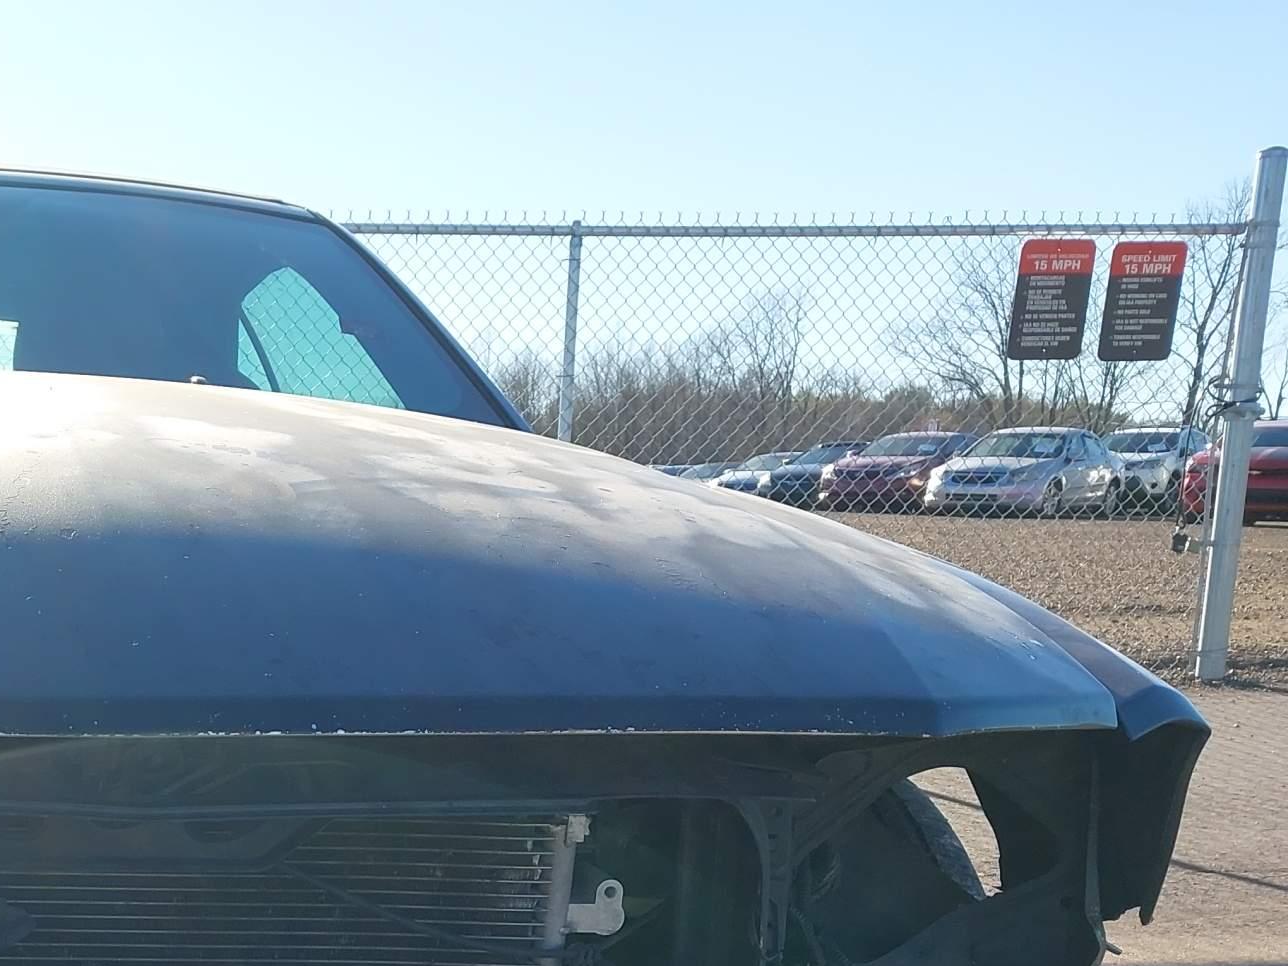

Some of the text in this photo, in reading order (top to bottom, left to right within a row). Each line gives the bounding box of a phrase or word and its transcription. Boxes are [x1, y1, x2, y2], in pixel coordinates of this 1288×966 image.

[1034, 260, 1081, 270] 15 MPH
[1124, 264, 1172, 274] 15 MPH
